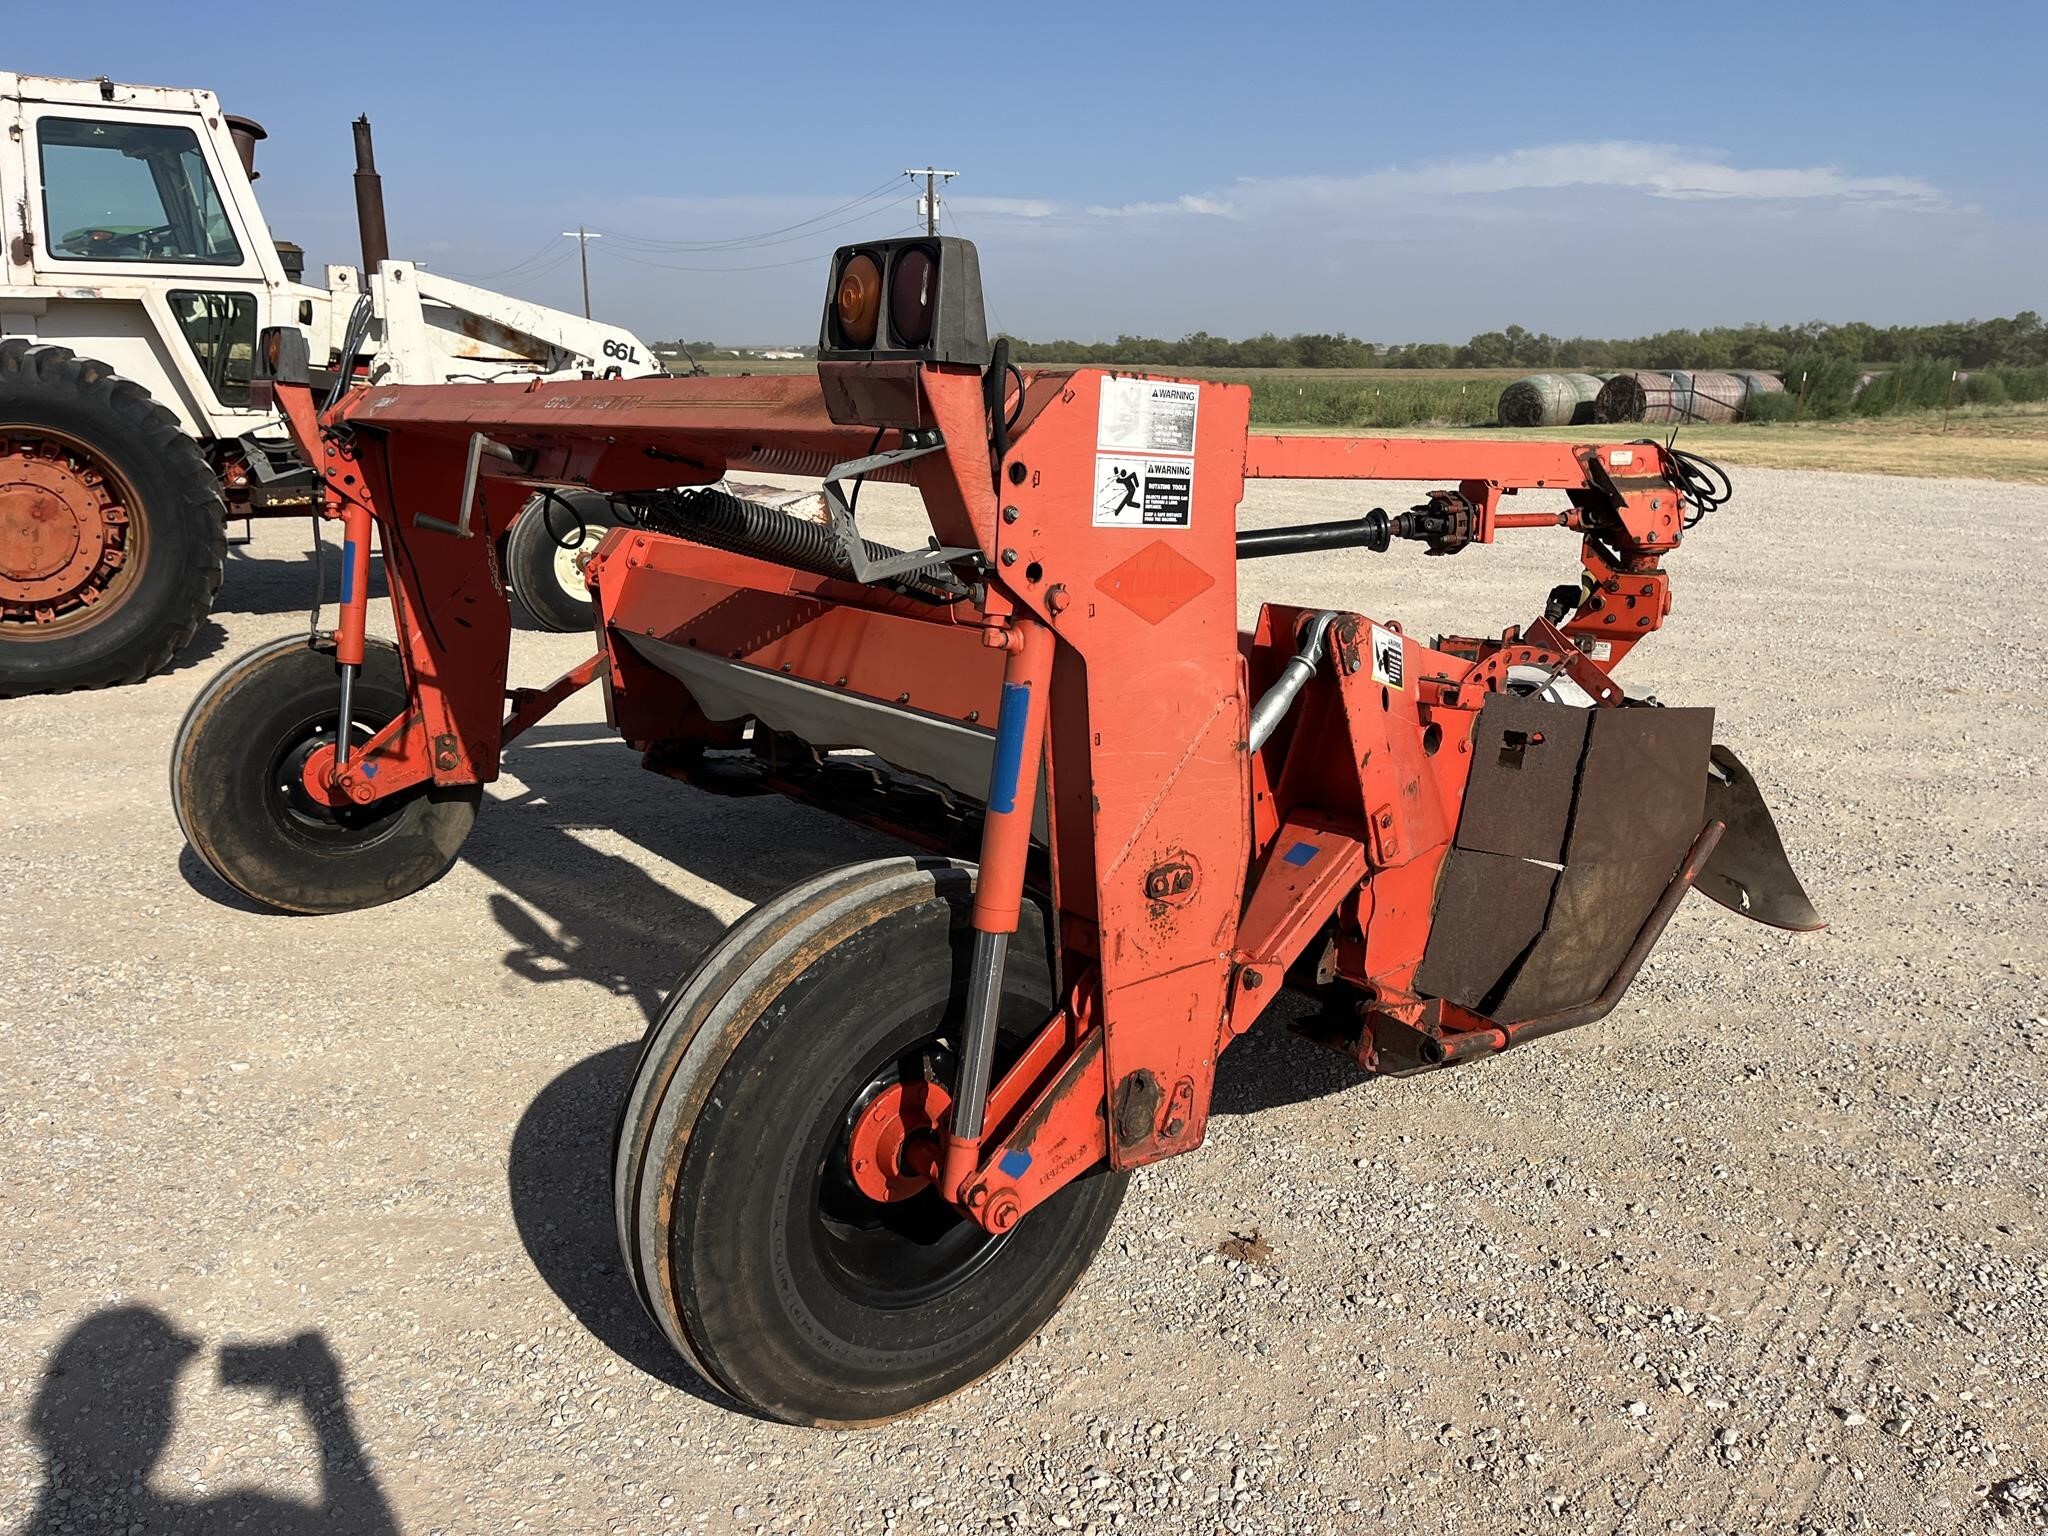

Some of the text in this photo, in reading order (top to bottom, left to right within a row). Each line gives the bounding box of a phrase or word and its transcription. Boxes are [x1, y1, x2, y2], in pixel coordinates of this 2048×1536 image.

[603, 339, 640, 366] 66L
[1159, 389, 1195, 401] WARNING
[1154, 465, 1190, 475] WARNING
